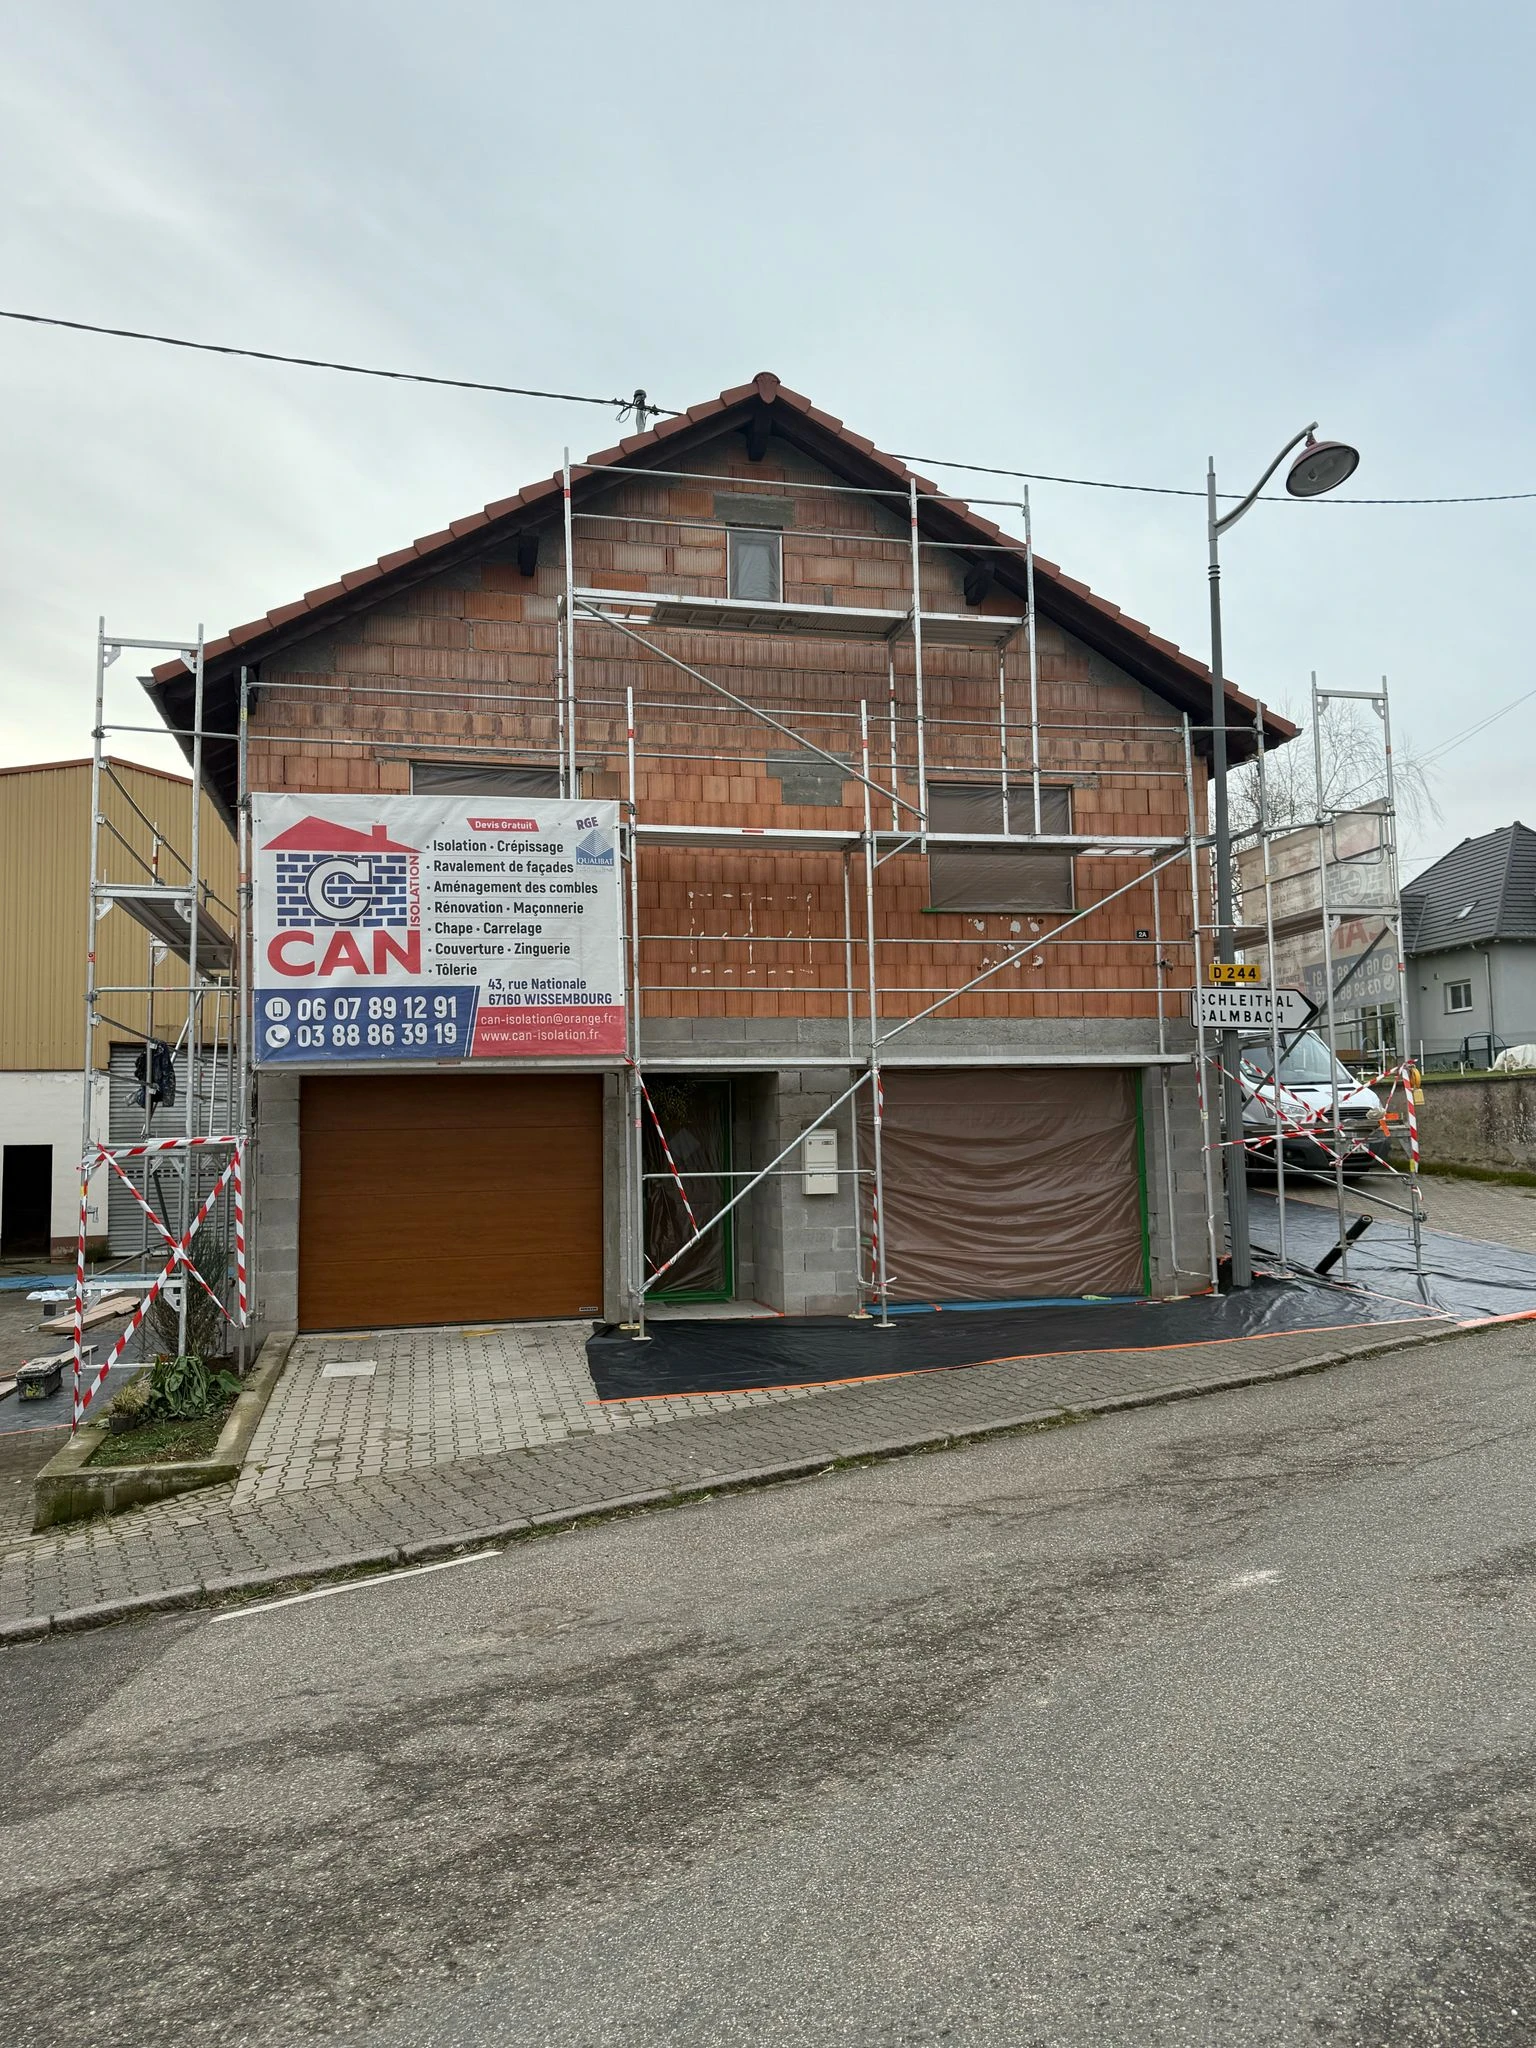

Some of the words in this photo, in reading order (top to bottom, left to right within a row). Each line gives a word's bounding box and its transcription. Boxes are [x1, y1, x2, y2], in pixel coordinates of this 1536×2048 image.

[475, 820, 500, 829] Devis
[501, 821, 533, 830] Gratuit
[576, 816, 599, 831] RGE
[433, 839, 487, 852] Isolation
[497, 839, 564, 855] Crépissage
[433, 859, 506, 873] Ravalement
[508, 861, 523, 873] de
[526, 860, 574, 876] façades
[577, 857, 614, 866] QUALIBAT
[409, 855, 421, 927] ISOLATION
[433, 879, 522, 895] Aménagement
[525, 881, 546, 894] des
[549, 881, 598, 894] combles
[434, 900, 503, 914] Rénovation
[513, 901, 584, 917] Maçonnerie
[434, 922, 473, 936] Chape
[483, 922, 542, 936] Carrelage
[267, 929, 421, 977] CAN
[435, 942, 504, 955] Couverture
[514, 942, 571, 957] Zinguerie
[436, 963, 477, 976] Tôlerie
[1213, 967, 1222, 979] D
[1227, 967, 1257, 979] 244
[488, 978, 505, 992] 43,
[508, 979, 528, 990] rue
[531, 978, 587, 990] Nationale
[489, 993, 521, 1006] 67160
[524, 993, 612, 1005] WISSEMBOURG
[297, 997, 327, 1021] 06
[334, 997, 362, 1020] 07
[368, 996, 397, 1020] 89
[403, 995, 427, 1019] 12
[433, 995, 457, 1019] 91
[480, 1012, 613, 1025] can-isolation@orange.fr
[297, 1024, 325, 1047] 03
[332, 1023, 360, 1047] 88
[367, 1023, 395, 1046] 86
[401, 1022, 428, 1045] 39
[433, 1022, 457, 1045] 19
[480, 1028, 600, 1041] www.can-isolation.fr
